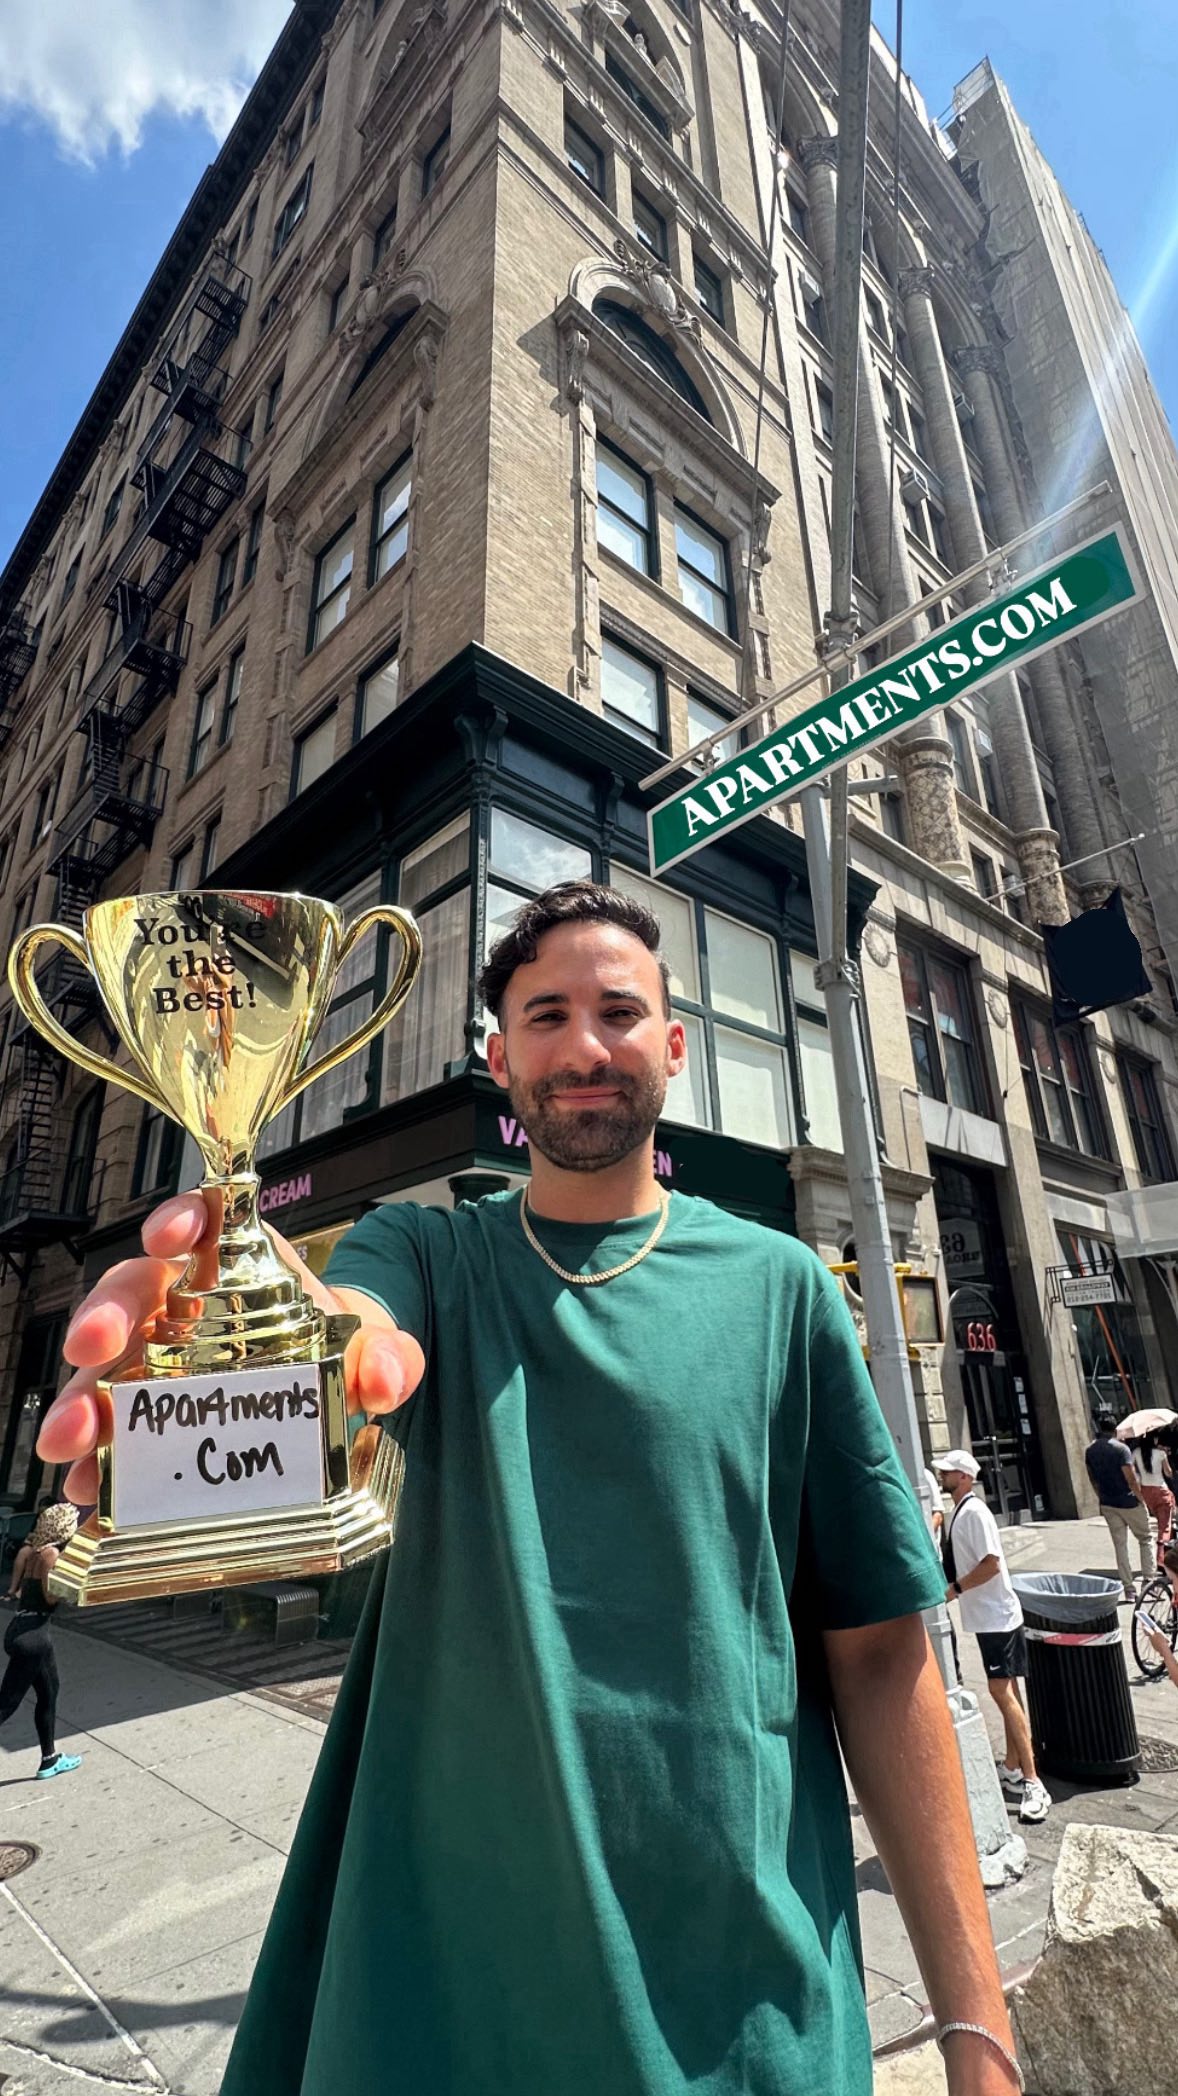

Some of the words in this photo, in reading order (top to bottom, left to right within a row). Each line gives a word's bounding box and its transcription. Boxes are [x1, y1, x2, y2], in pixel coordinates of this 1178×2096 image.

[681, 577, 1077, 837] APARTMENTS.COM
[166, 949, 236, 979] the
[153, 982, 257, 1014] Best!
[259, 1173, 312, 1213] CREAM
[967, 1322, 997, 1351] 636
